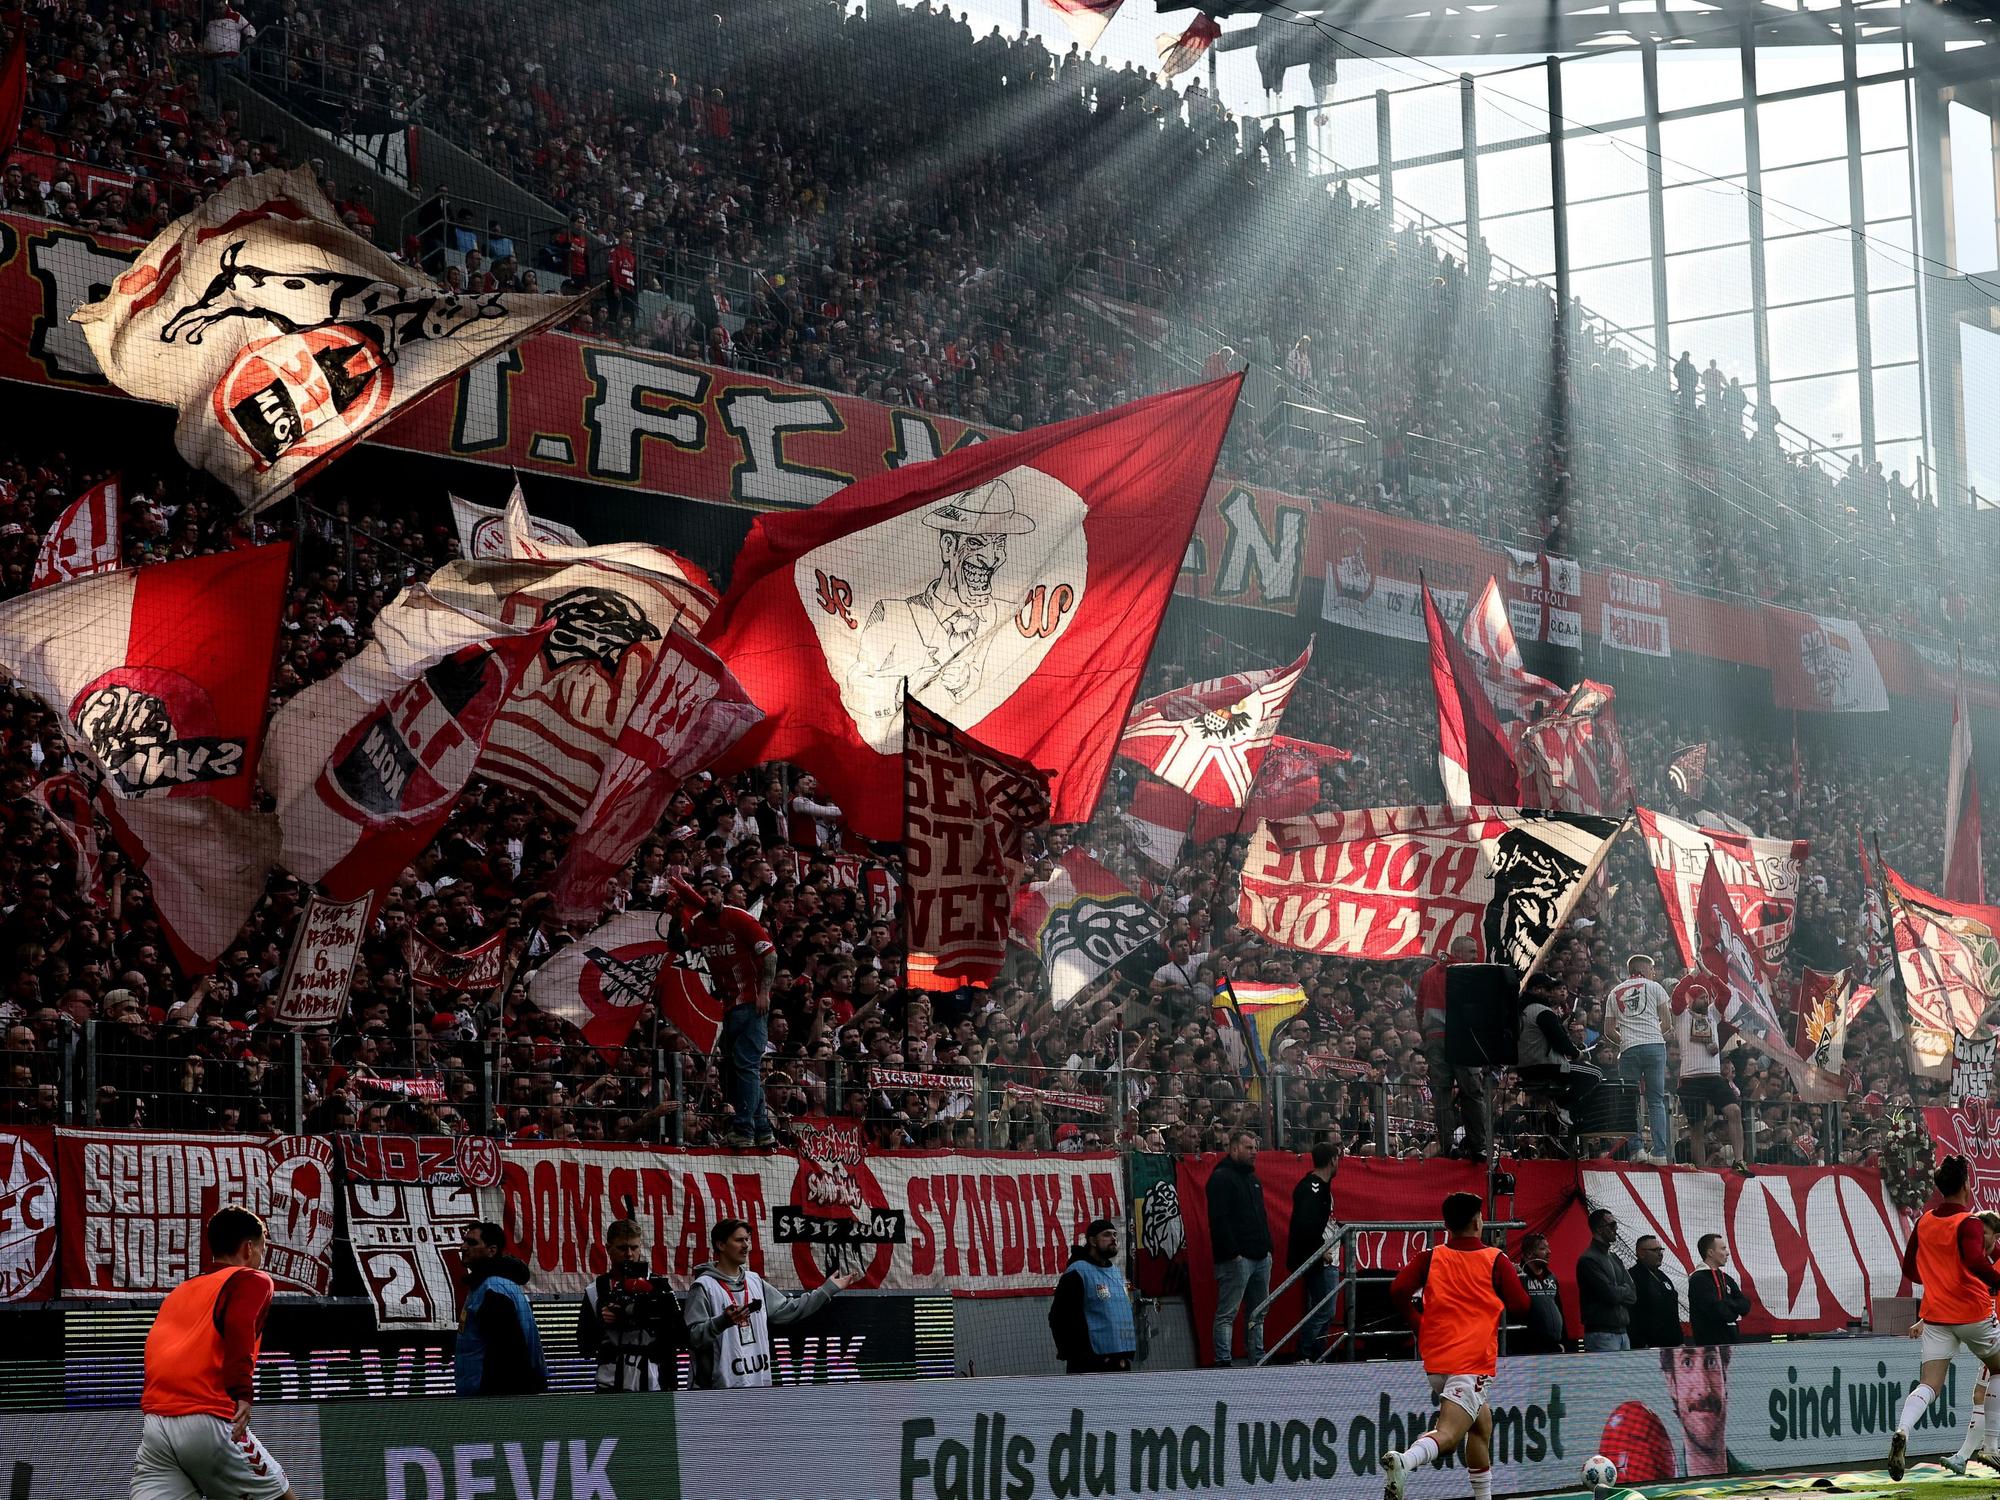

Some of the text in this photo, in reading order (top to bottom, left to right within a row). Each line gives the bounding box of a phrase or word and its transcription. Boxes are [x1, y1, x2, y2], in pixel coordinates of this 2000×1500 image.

[314, 949, 328, 972] 6
[700, 942, 738, 960] REWE
[85, 1143, 272, 1215] SEMPER
[1768, 1365, 1842, 1442] sind
[1848, 1360, 1902, 1435] wir
[901, 1411, 1036, 1500] Falls
[1047, 1407, 1117, 1499] du
[1129, 1400, 1226, 1493] mal
[1237, 1416, 1339, 1482] was
